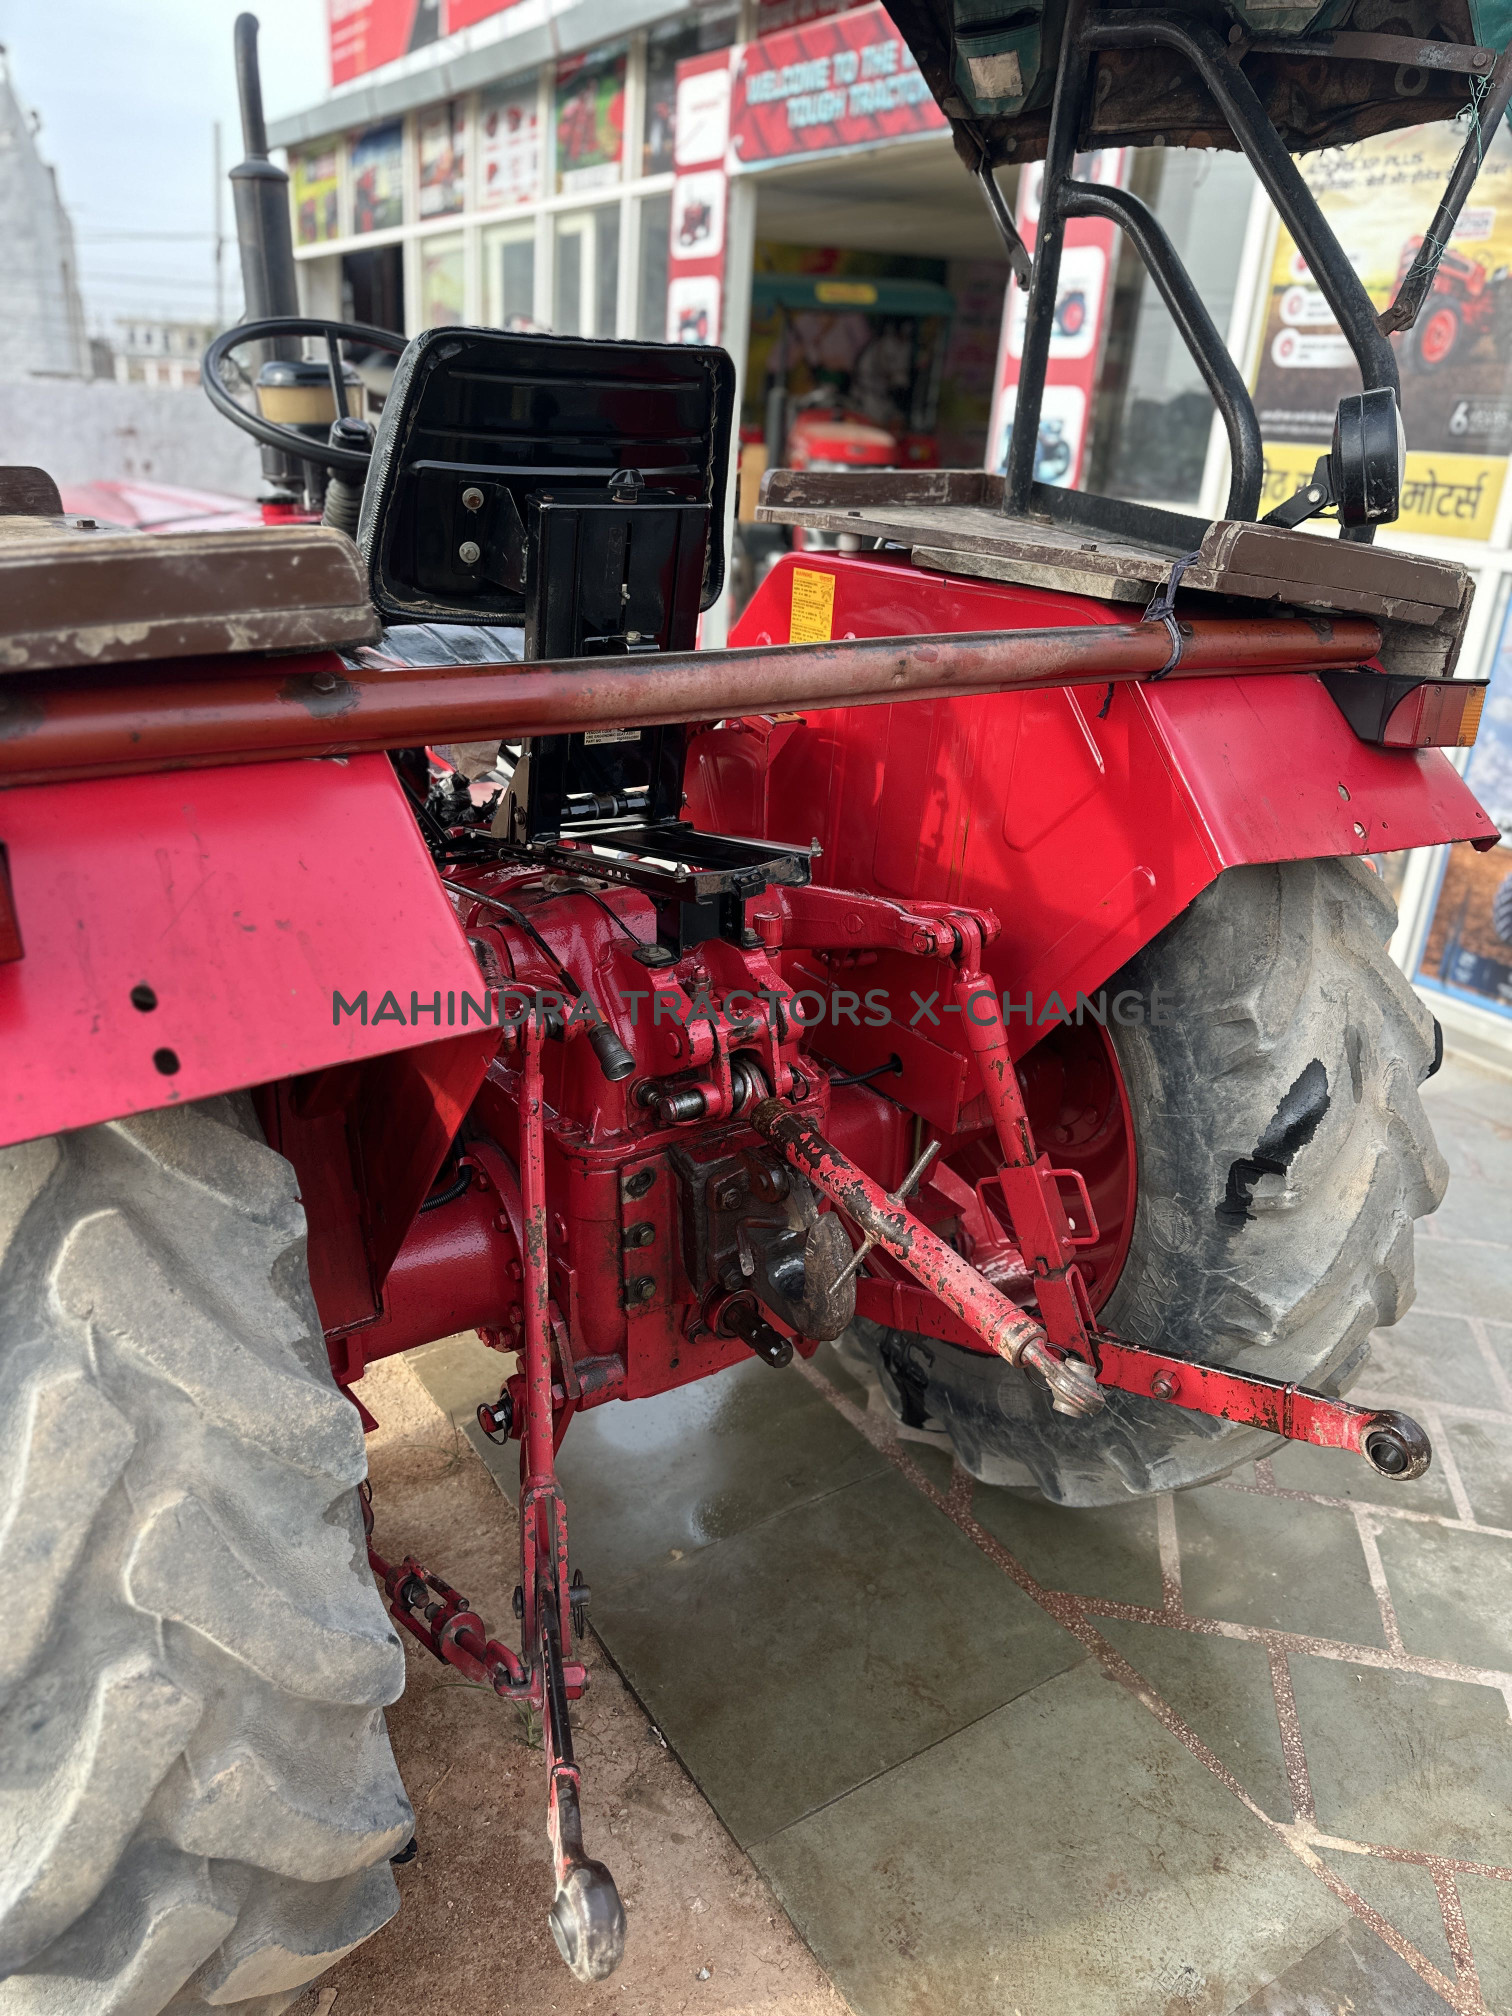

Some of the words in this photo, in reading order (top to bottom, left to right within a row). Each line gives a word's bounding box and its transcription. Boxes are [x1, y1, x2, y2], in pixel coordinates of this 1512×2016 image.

[746, 57, 830, 105] WELCOME
[833, 50, 858, 84] TO
[861, 39, 898, 78] THE
[787, 89, 847, 129] TOUGH
[1450, 401, 1469, 436] 6
